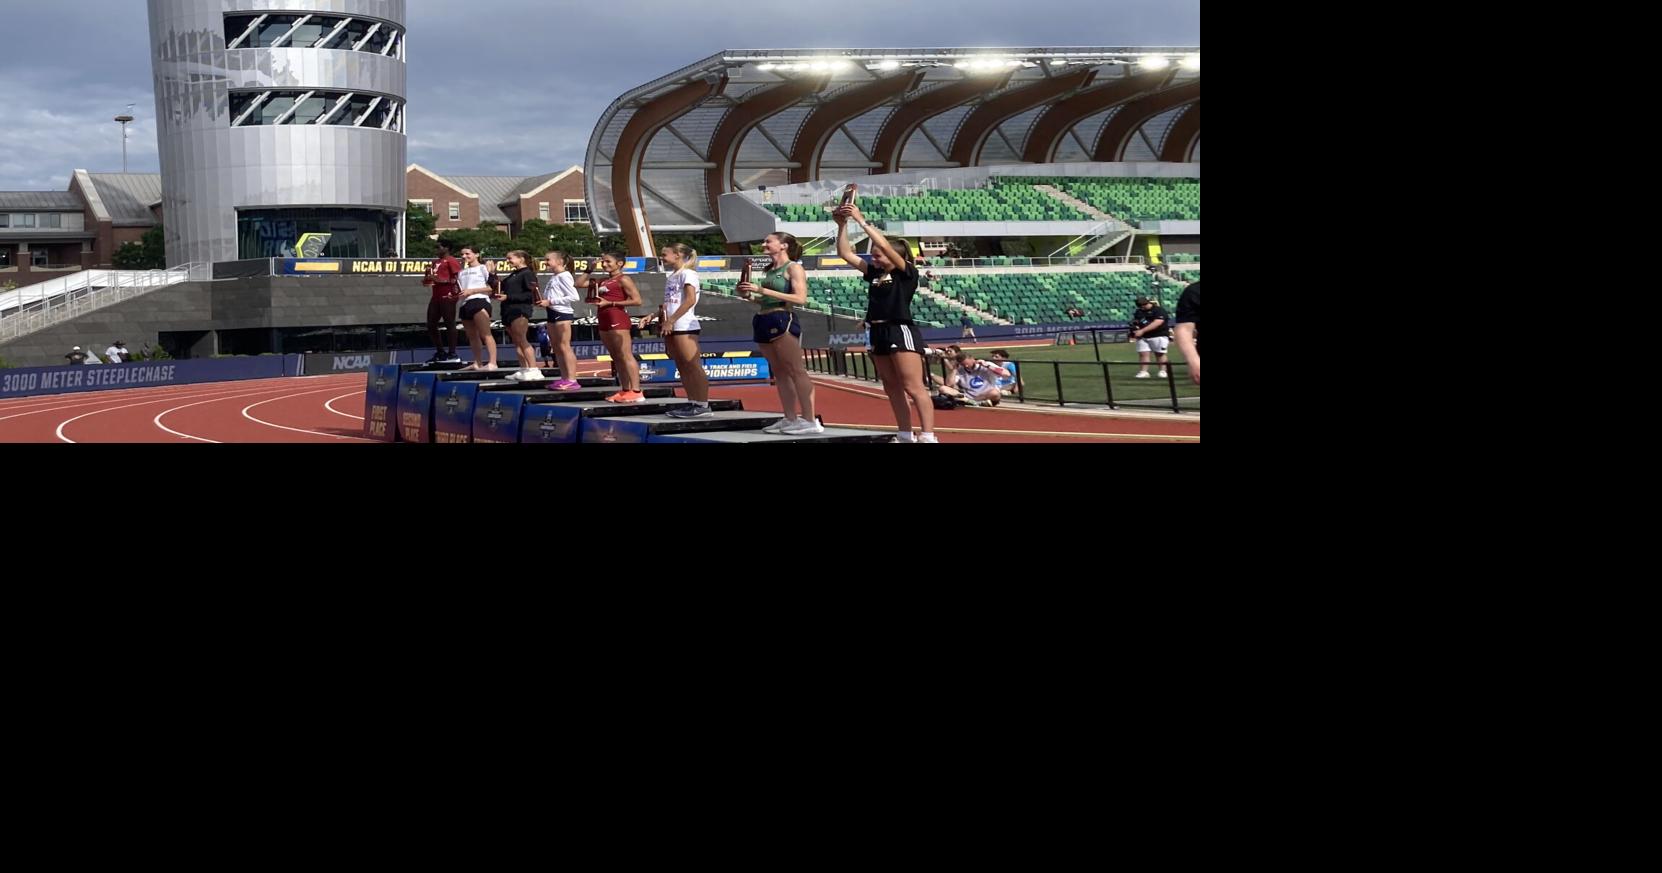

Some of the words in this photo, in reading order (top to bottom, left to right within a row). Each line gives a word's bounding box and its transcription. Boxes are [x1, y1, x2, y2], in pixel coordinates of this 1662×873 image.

[352, 261, 382, 272] NCAA
[385, 261, 397, 272] DI
[400, 261, 432, 272] TRAC
[332, 355, 371, 370] NCAA
[3, 373, 37, 392] 3000
[41, 370, 83, 389] METER
[87, 365, 176, 386] STEEPLECHASE
